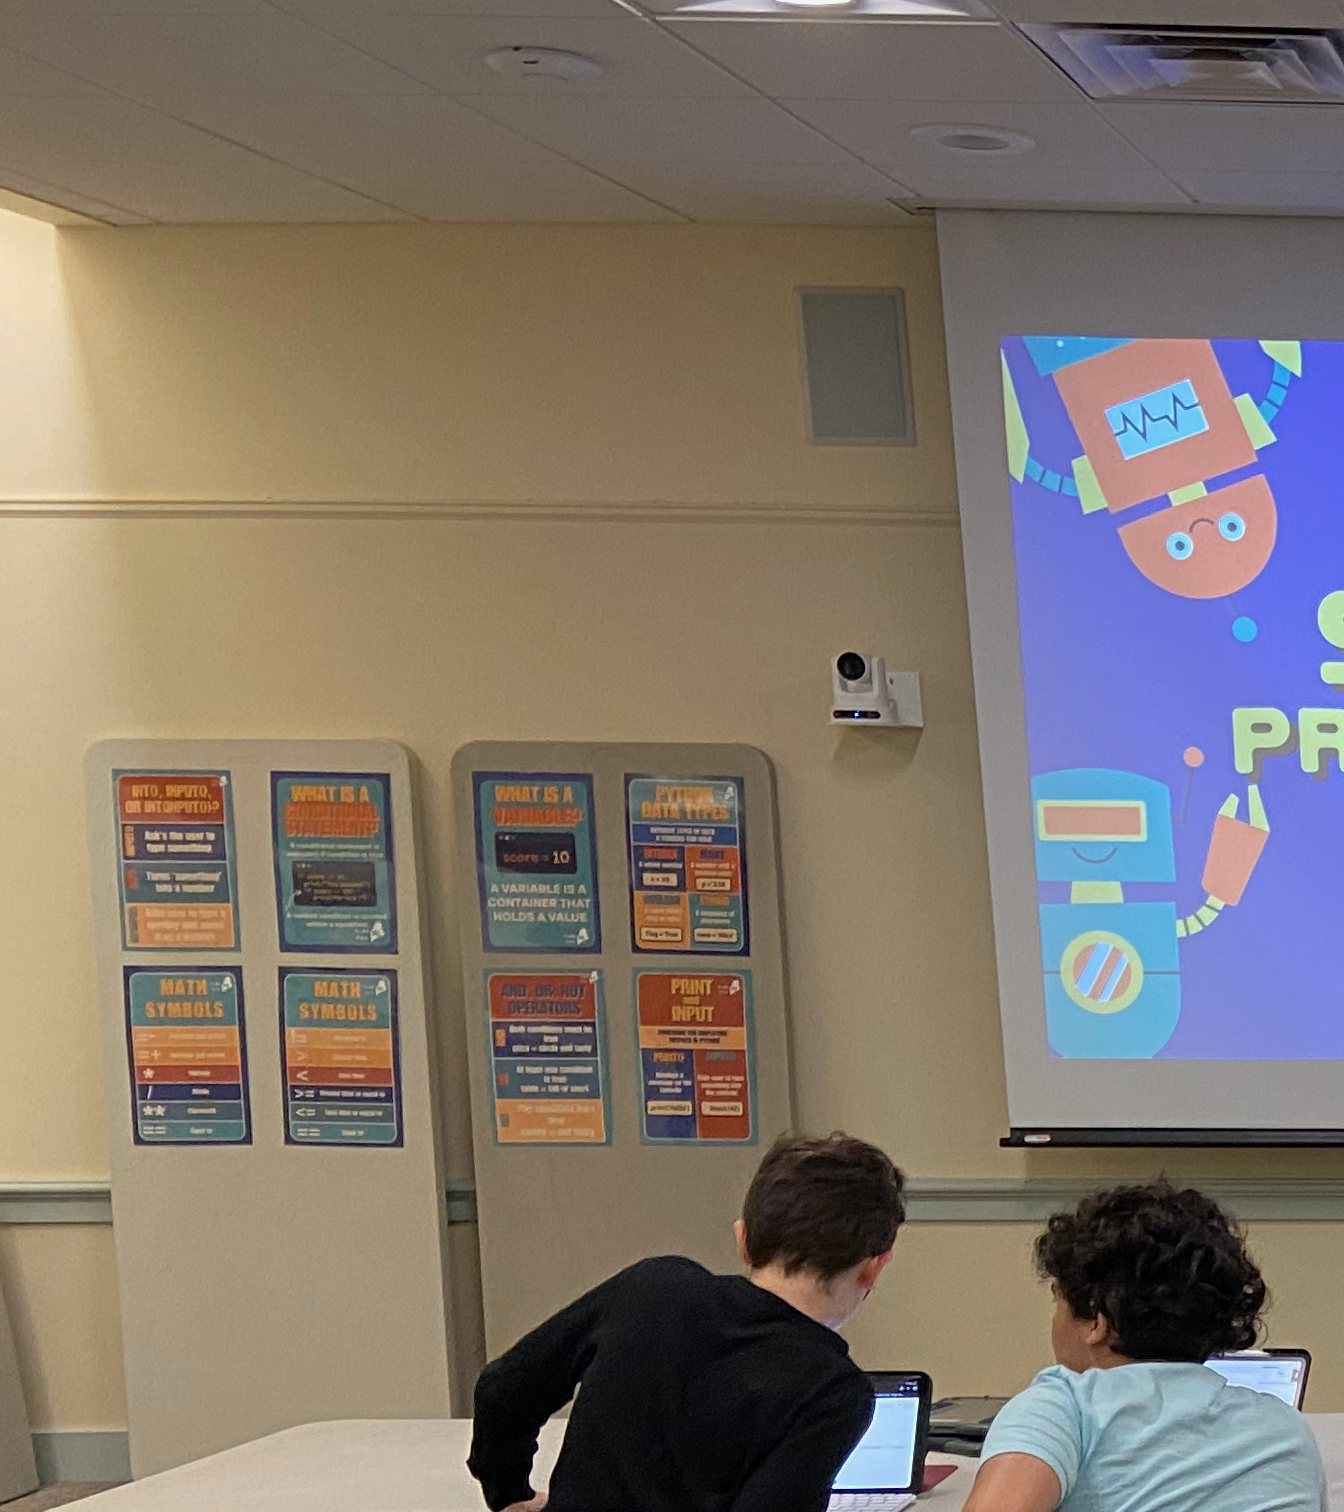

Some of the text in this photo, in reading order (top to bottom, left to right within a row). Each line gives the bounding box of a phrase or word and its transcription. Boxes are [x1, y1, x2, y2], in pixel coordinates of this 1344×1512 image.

[290, 785, 369, 803] WHAT IS A
[494, 786, 573, 803] WHAT IS A
[503, 854, 539, 863] score
[552, 851, 570, 865] 10
[490, 884, 586, 894] A VARIABLE IS A
[487, 898, 591, 908] CONTAINER THAT
[493, 912, 588, 923] HOLDS A VALUE
[160, 979, 207, 996] MATH
[314, 981, 361, 998] MATH
[671, 979, 714, 996] PRINT
[145, 1001, 224, 1018] SYMBOLS
[299, 1003, 377, 1021] SYMBOLS
[508, 1001, 582, 1015] OPERATORS
[672, 1006, 715, 1022] INPUT
